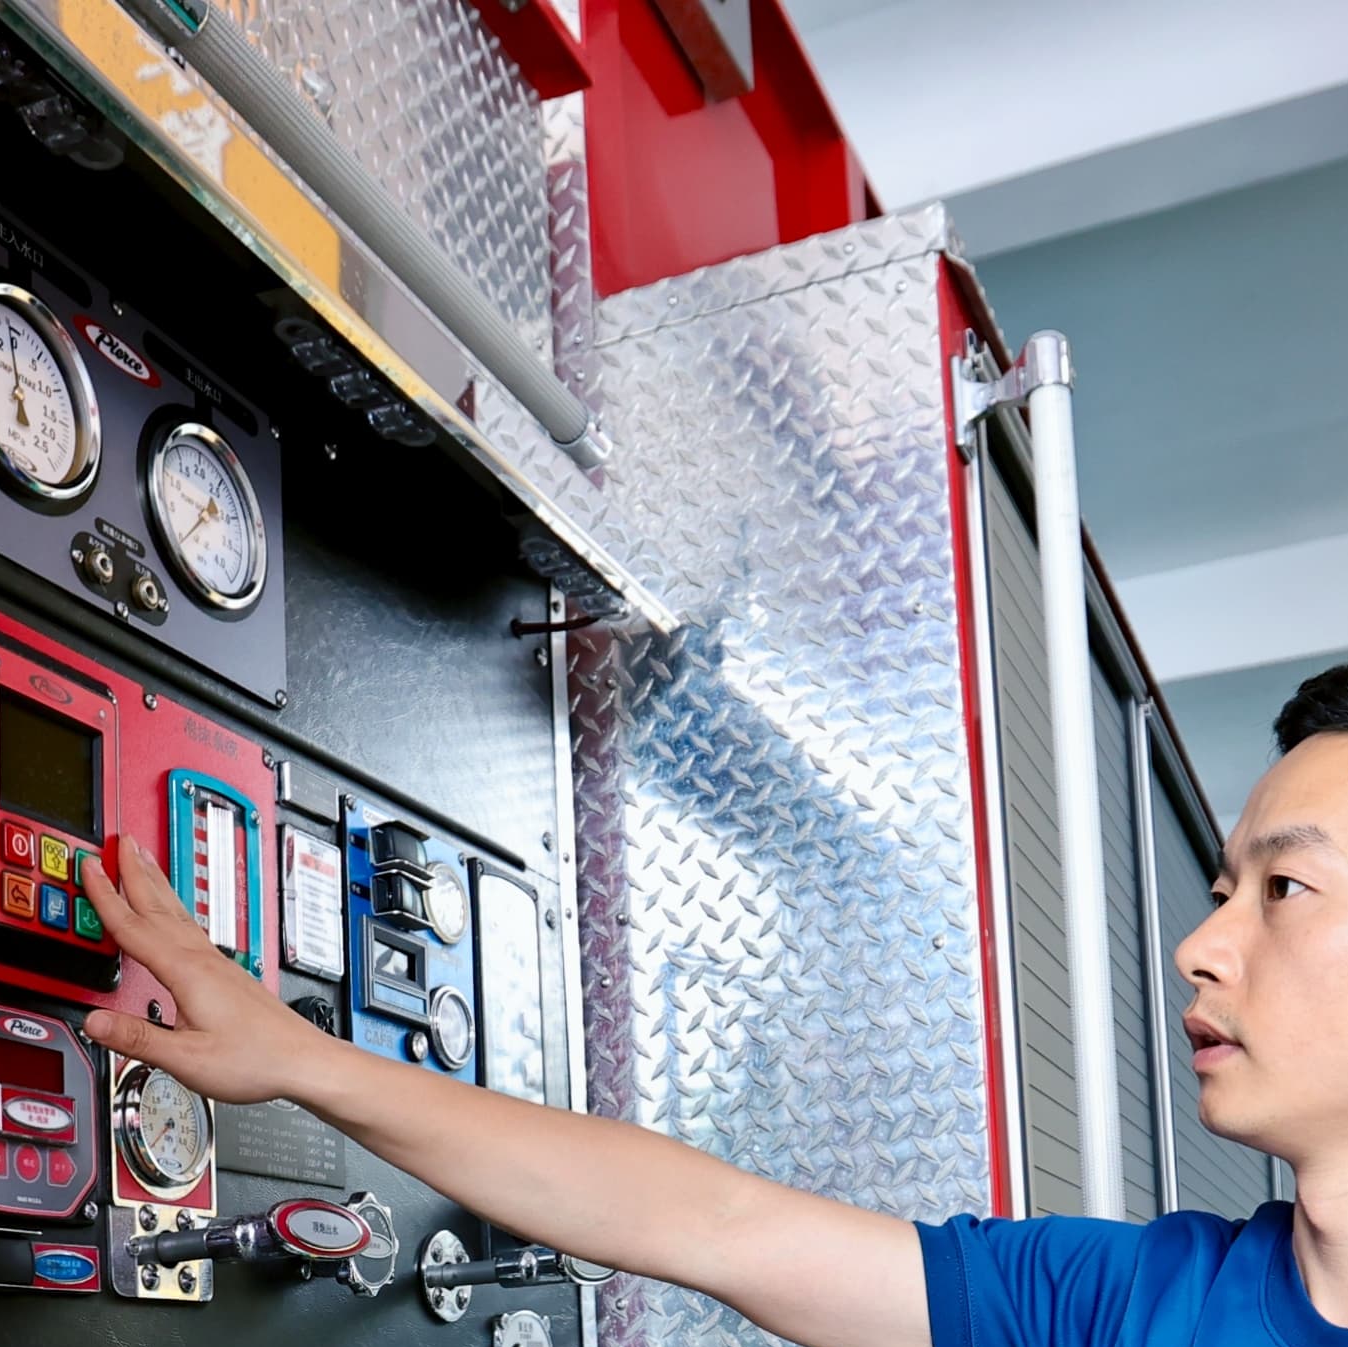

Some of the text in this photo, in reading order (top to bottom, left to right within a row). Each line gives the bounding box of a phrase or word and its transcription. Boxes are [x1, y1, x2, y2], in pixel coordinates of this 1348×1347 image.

[96, 328, 144, 375] Pierce
[185, 366, 222, 405] 主出水口
[10, 1018, 43, 1038] Pierce
